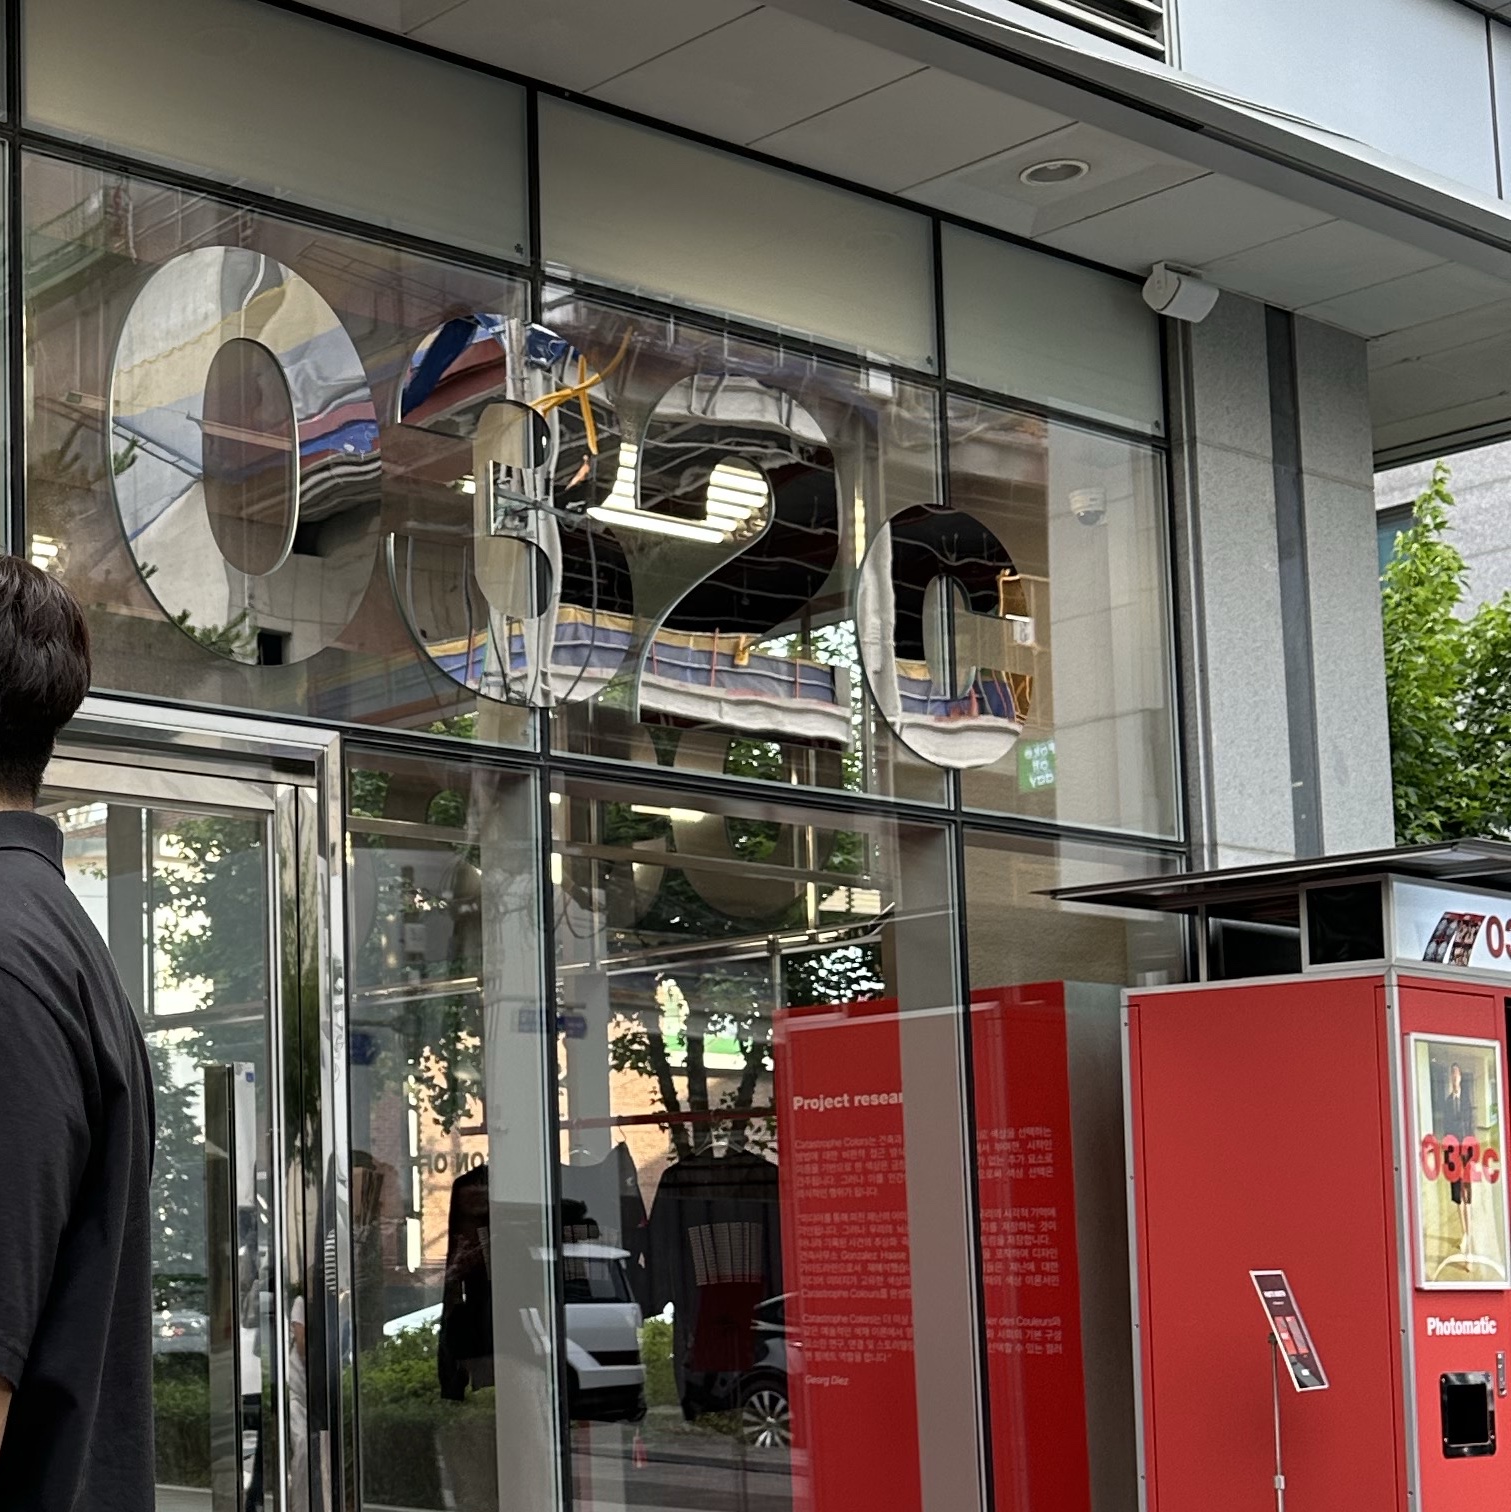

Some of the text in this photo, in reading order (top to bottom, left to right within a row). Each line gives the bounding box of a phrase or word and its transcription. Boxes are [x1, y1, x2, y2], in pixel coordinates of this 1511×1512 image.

[110, 244, 1030, 767] 032c
[793, 1093, 850, 1112] Project
[1421, 1134, 1499, 1183] 032c
[1426, 1315, 1497, 1336] Photomatic
[805, 1375, 849, 1387] Georg Diez
